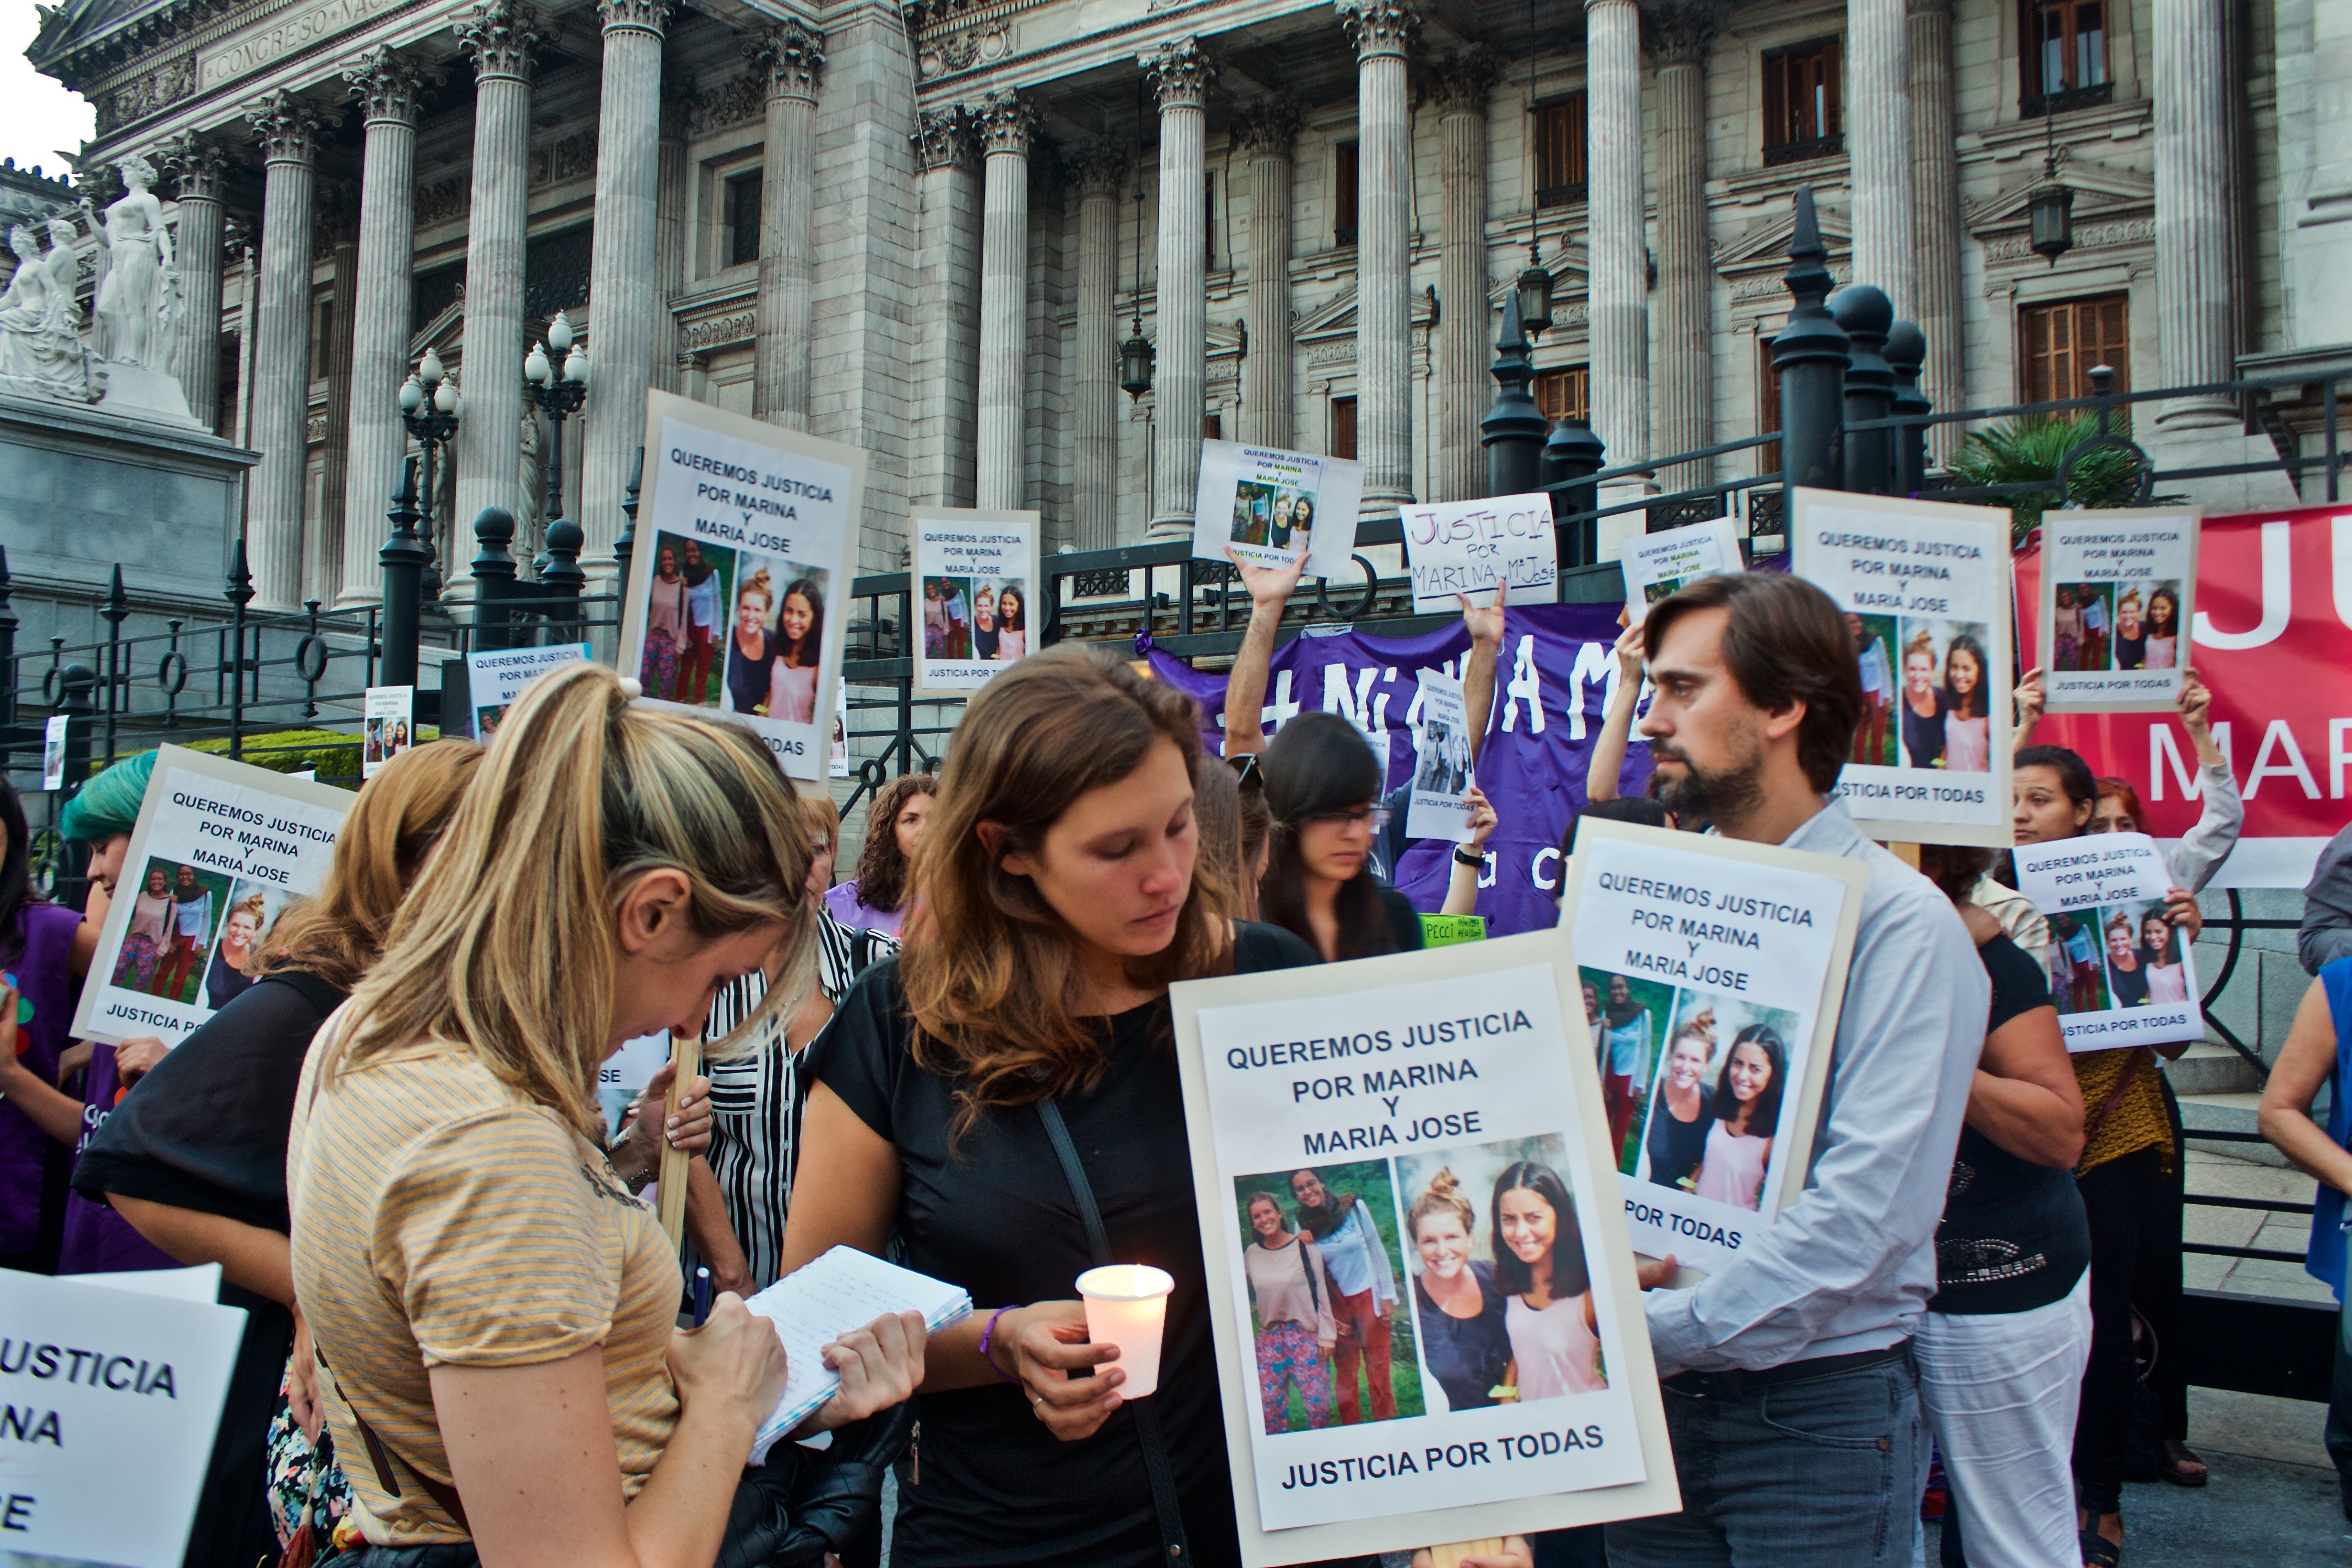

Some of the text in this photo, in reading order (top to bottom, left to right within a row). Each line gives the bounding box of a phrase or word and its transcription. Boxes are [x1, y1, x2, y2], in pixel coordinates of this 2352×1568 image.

[216, 10, 326, 78] CONGRESO
[1244, 449, 1319, 466] QUEREMOS JUSTICIA
[671, 448, 833, 503] QUEREMOS JUSTICIA
[1274, 464, 1302, 473] MARINA
[1256, 474, 1299, 486] MARIA JOSE
[697, 483, 797, 520] POR MARINA
[742, 511, 752, 527] Y
[695, 518, 791, 553] MARIA JOSE
[924, 533, 1021, 544] QUEREMOS JUSTICIA
[2060, 531, 2180, 546] QUEREMOS JUSTICIA
[944, 547, 1001, 557] POR MARINA
[1466, 543, 1500, 559] POR
[1637, 536, 1713, 558] QUEREMOS JUSTICIA
[1819, 531, 1982, 560] QUEREMOS JUSTICIA
[2082, 548, 2155, 559] POR MARINA
[1654, 549, 1700, 565] POR MARINA
[2116, 559, 2122, 568] Y
[945, 565, 1001, 574] MARIA JOSE
[1657, 563, 1702, 579] MARIA JOSE
[1852, 559, 1951, 581] POR MARINA
[2083, 567, 2153, 578] MARIA JOSE
[1413, 564, 1496, 595] MARINA
[1898, 580, 1907, 593] Y
[1853, 592, 1949, 613] MARIA JOSE
[476, 651, 579, 668] QUEREMOS JUSTICIA
[499, 671, 521, 681] POR
[928, 669, 969, 677] JUSTICIA
[1427, 684, 1447, 697] QUEREMOS
[2056, 678, 2171, 691] JUSTICIA POR TODAS
[1444, 701, 1458, 710] MARINA
[761, 737, 804, 755] ODAS
[1895, 785, 1928, 801] POR
[1932, 787, 1985, 804] TODAS
[1414, 798, 1438, 807] JUSTICIA
[1453, 802, 1475, 812] TODAS
[173, 792, 336, 845] QUEREMOS JUSTICIA
[199, 821, 299, 858] POR MARINA
[243, 847, 254, 859] Y
[2026, 848, 2153, 873] QUEREMOS JUSTICIA
[192, 848, 290, 884] MARIA JOSE
[2056, 864, 2137, 886] POR MARINA
[2095, 881, 2103, 891] Y
[1599, 872, 1813, 928] QUEREMOS JUSTICIA
[2060, 887, 2138, 907] MARIA JOSE
[1631, 910, 1761, 950] POR MARINA
[1687, 941, 1701, 957] Y
[1625, 950, 1749, 991] MARIA JOSE
[106, 1003, 179, 1031] JUSTICIA
[2110, 1020, 2138, 1032] POR
[2142, 1014, 2187, 1028] TODAS
[1227, 1009, 1533, 1071] QUEREMOS JUSTICIA
[1292, 1058, 1478, 1104] POR MARINA
[1381, 1096, 1401, 1118] Y
[1303, 1110, 1483, 1156] MARIA JOSE
[1624, 1200, 1742, 1250] POR TODAS
[0, 1404, 63, 1447] NA
[1281, 1424, 1604, 1490] JUSTICIA POR TODAS
